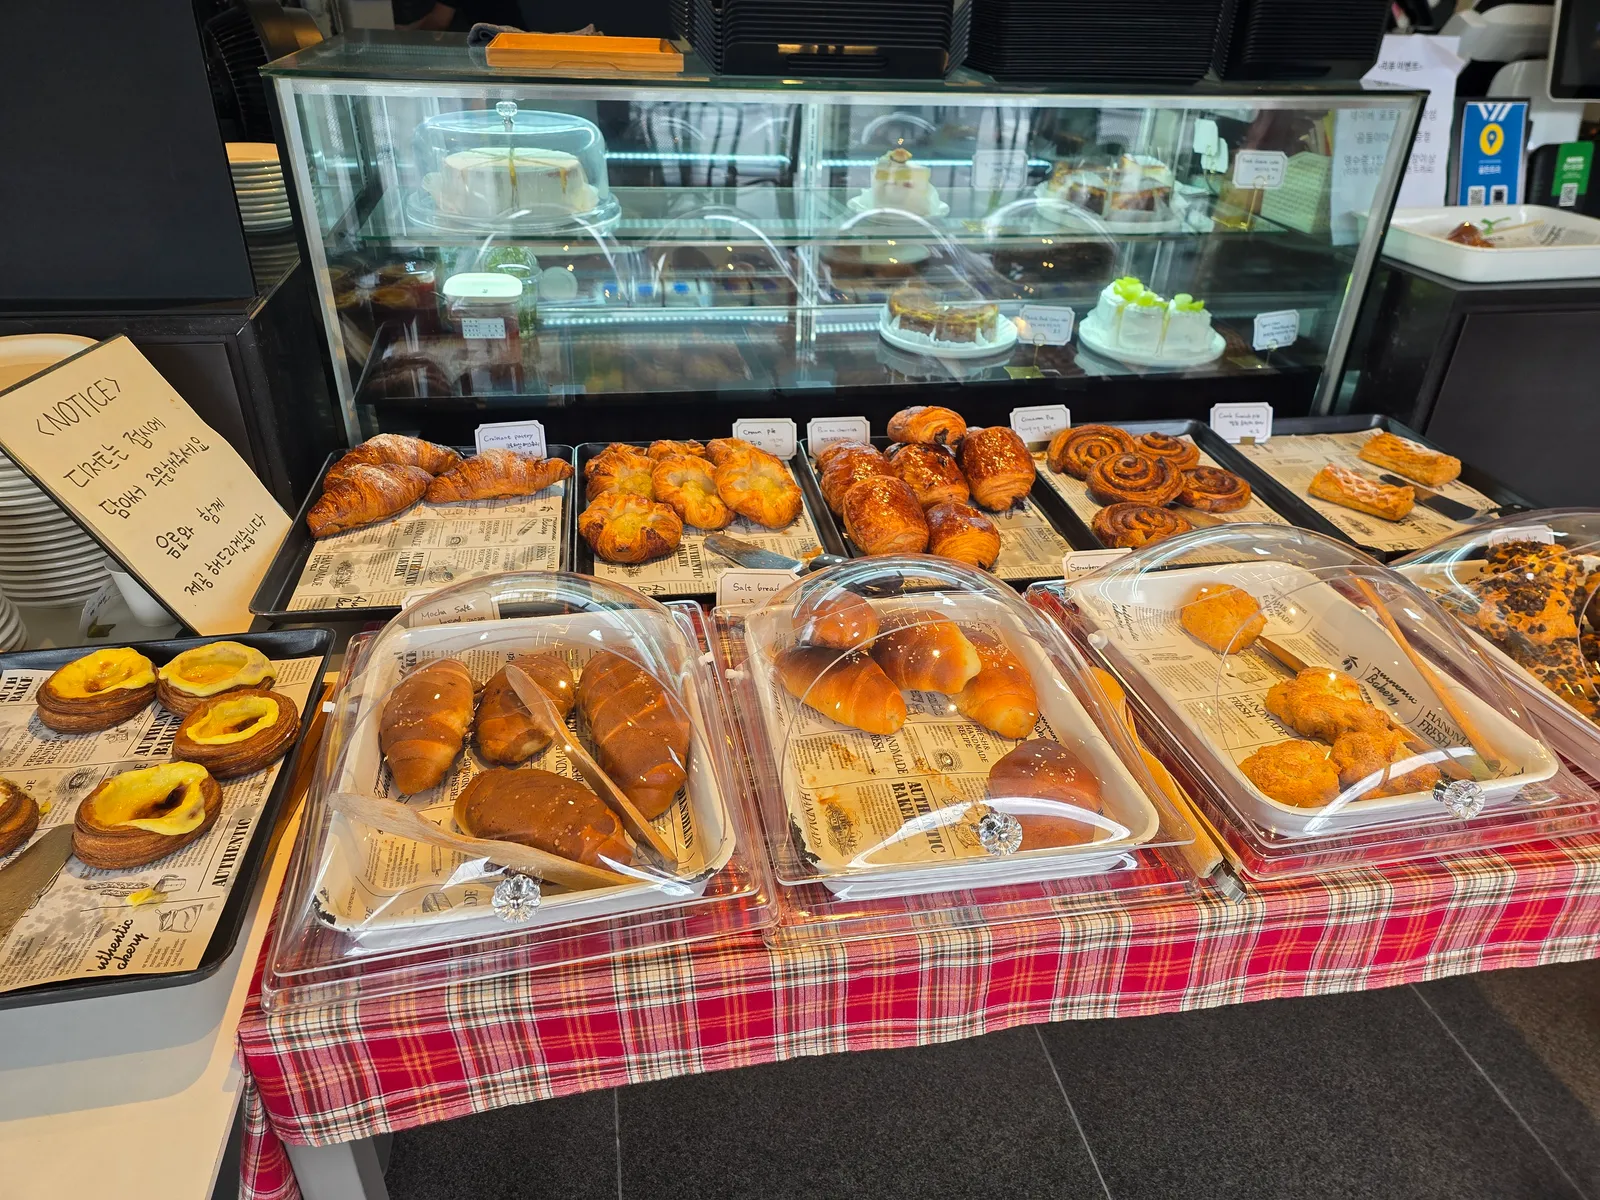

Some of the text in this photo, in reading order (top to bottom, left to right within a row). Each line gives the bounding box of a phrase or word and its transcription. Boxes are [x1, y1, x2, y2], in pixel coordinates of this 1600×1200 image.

[63, 416, 167, 488] 디저트는 접시에
[98, 436, 210, 520] 담아서 주문해주세요
[155, 497, 225, 560] 음료와 함께
[184, 513, 267, 596] 제공 해드리겠습니다
[688, 543, 704, 579] AUTHENTIC
[733, 582, 780, 592] Salt bread
[421, 604, 473, 620] Mocha Salt
[1228, 696, 1256, 719] FRESH
[1365, 674, 1400, 706] Bakery
[1240, 694, 1290, 738] HANDMADE
[1416, 719, 1452, 749] FRESH
[1425, 709, 1473, 748] HANDMA
[34, 732, 64, 766] HANDMA
[885, 734, 909, 775] ANDMADE
[957, 725, 973, 748] RECIPE
[965, 724, 990, 763] HANDMADE
[974, 724, 991, 750] FRESH&
[460, 756, 473, 793] ANDMADE
[212, 818, 252, 887] AUTHENTIC
[88, 919, 134, 971] uthentic
[113, 932, 150, 970] akery
